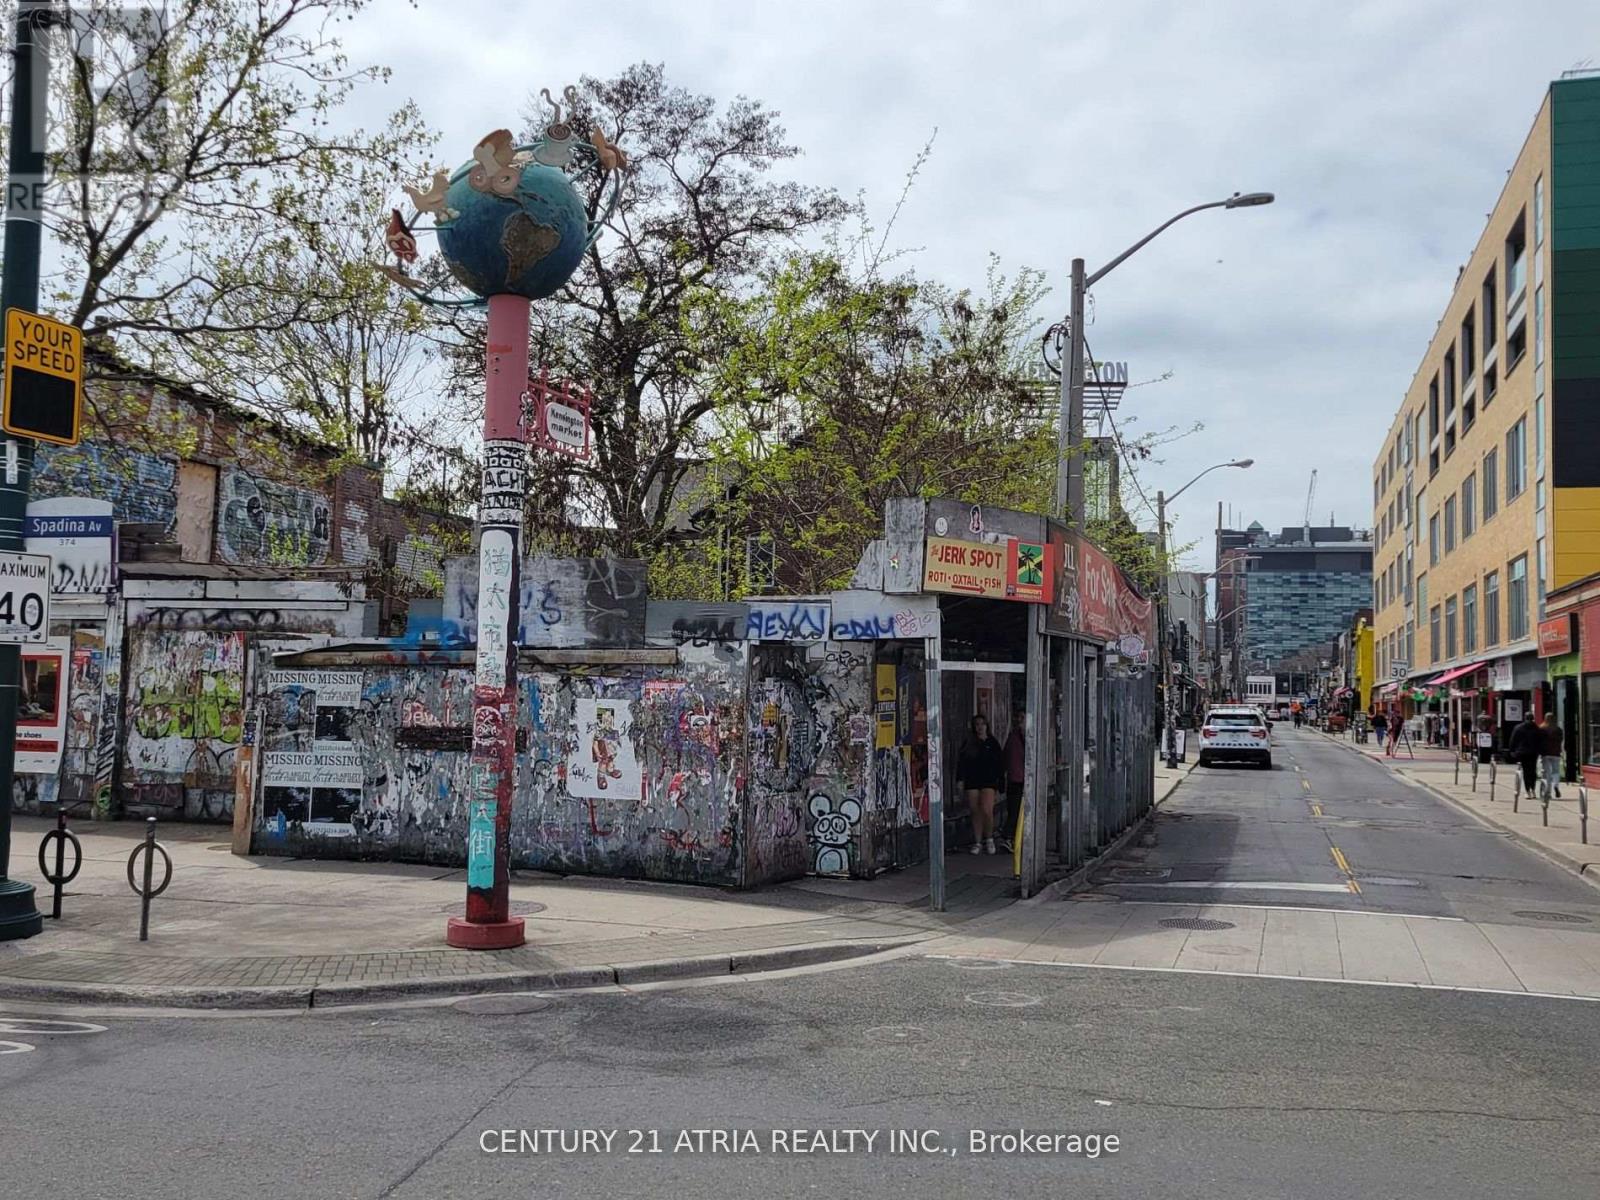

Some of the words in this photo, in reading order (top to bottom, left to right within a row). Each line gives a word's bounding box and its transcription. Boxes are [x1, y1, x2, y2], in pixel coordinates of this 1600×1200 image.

[18, 318, 72, 351] YOUR
[14, 340, 75, 373] SPEED
[550, 408, 583, 427] Kensington
[551, 423, 582, 438] market
[33, 518, 85, 535] Spadina
[89, 521, 102, 532] Av
[938, 545, 967, 566] JERK
[970, 549, 1002, 569] SPOT
[0, 563, 46, 579] AXIMUM
[928, 571, 946, 582] ROTI
[953, 574, 979, 586] OXTAIL
[984, 577, 1001, 588] FISH
[1085, 553, 1100, 600] For
[0, 591, 43, 631] 40
[270, 672, 315, 683] MISSING
[1391, 667, 1406, 677] 30
[265, 754, 312, 766] MISSING
